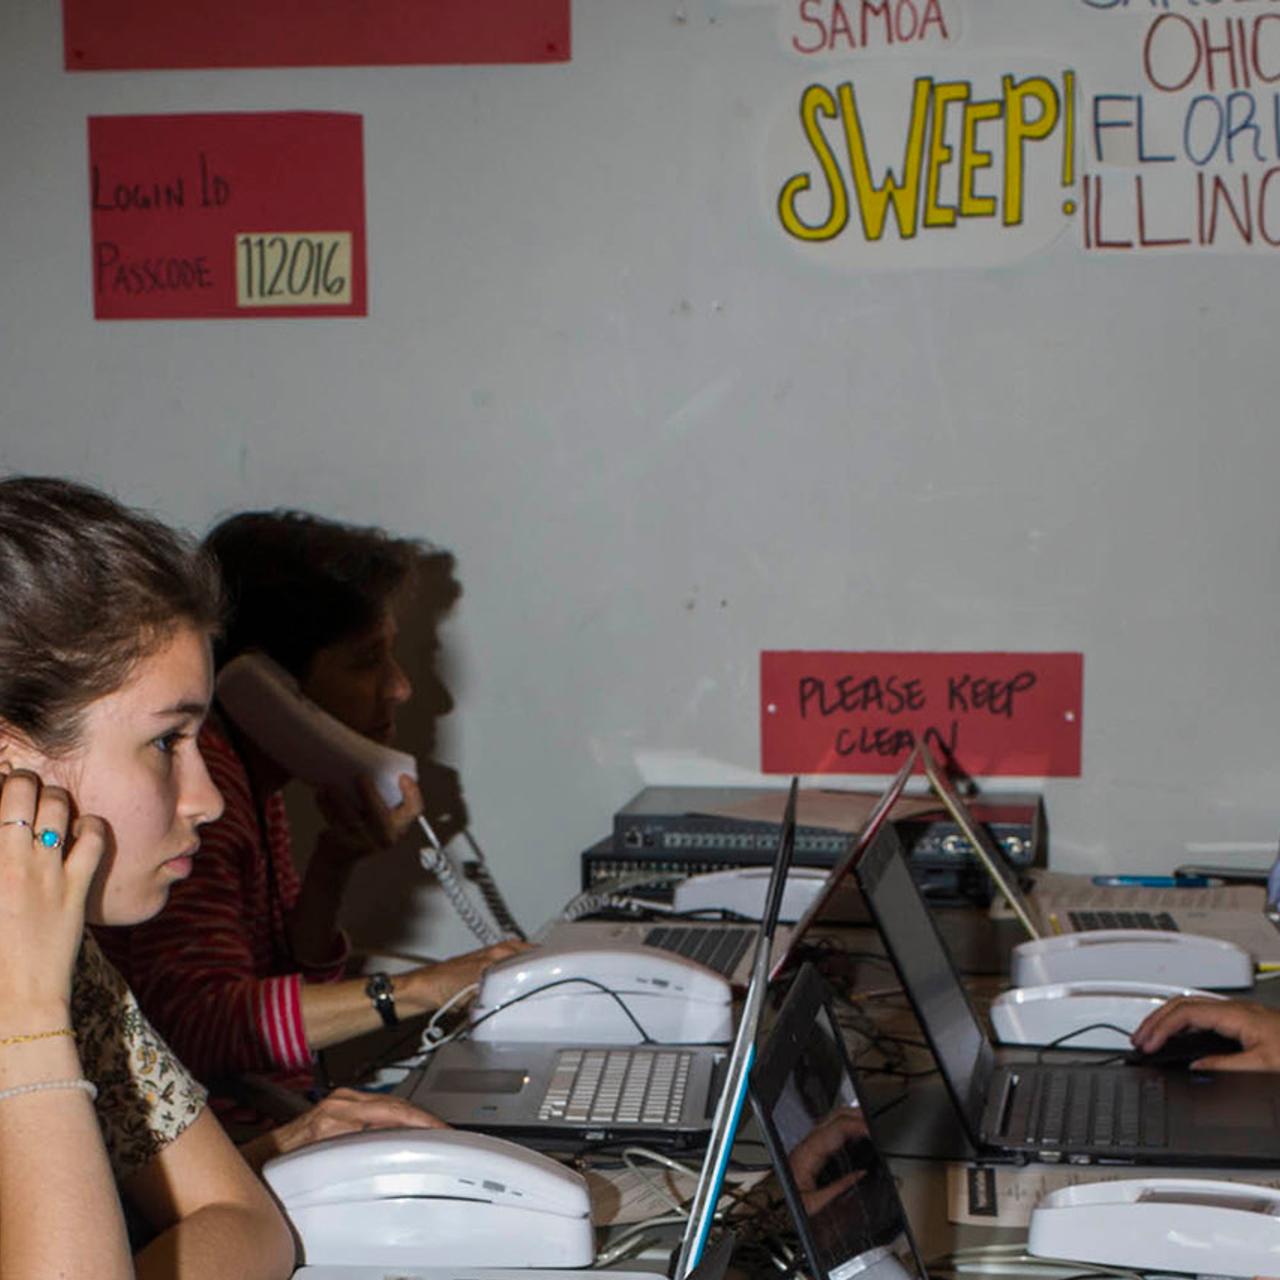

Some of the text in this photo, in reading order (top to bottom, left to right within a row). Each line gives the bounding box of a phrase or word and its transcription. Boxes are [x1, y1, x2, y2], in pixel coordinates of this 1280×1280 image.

[793, 0, 949, 53] SAMOA
[778, 70, 1075, 242] SWEEP!
[239, 236, 346, 298] 112016
[798, 670, 1038, 719] PLEASE KEEP
